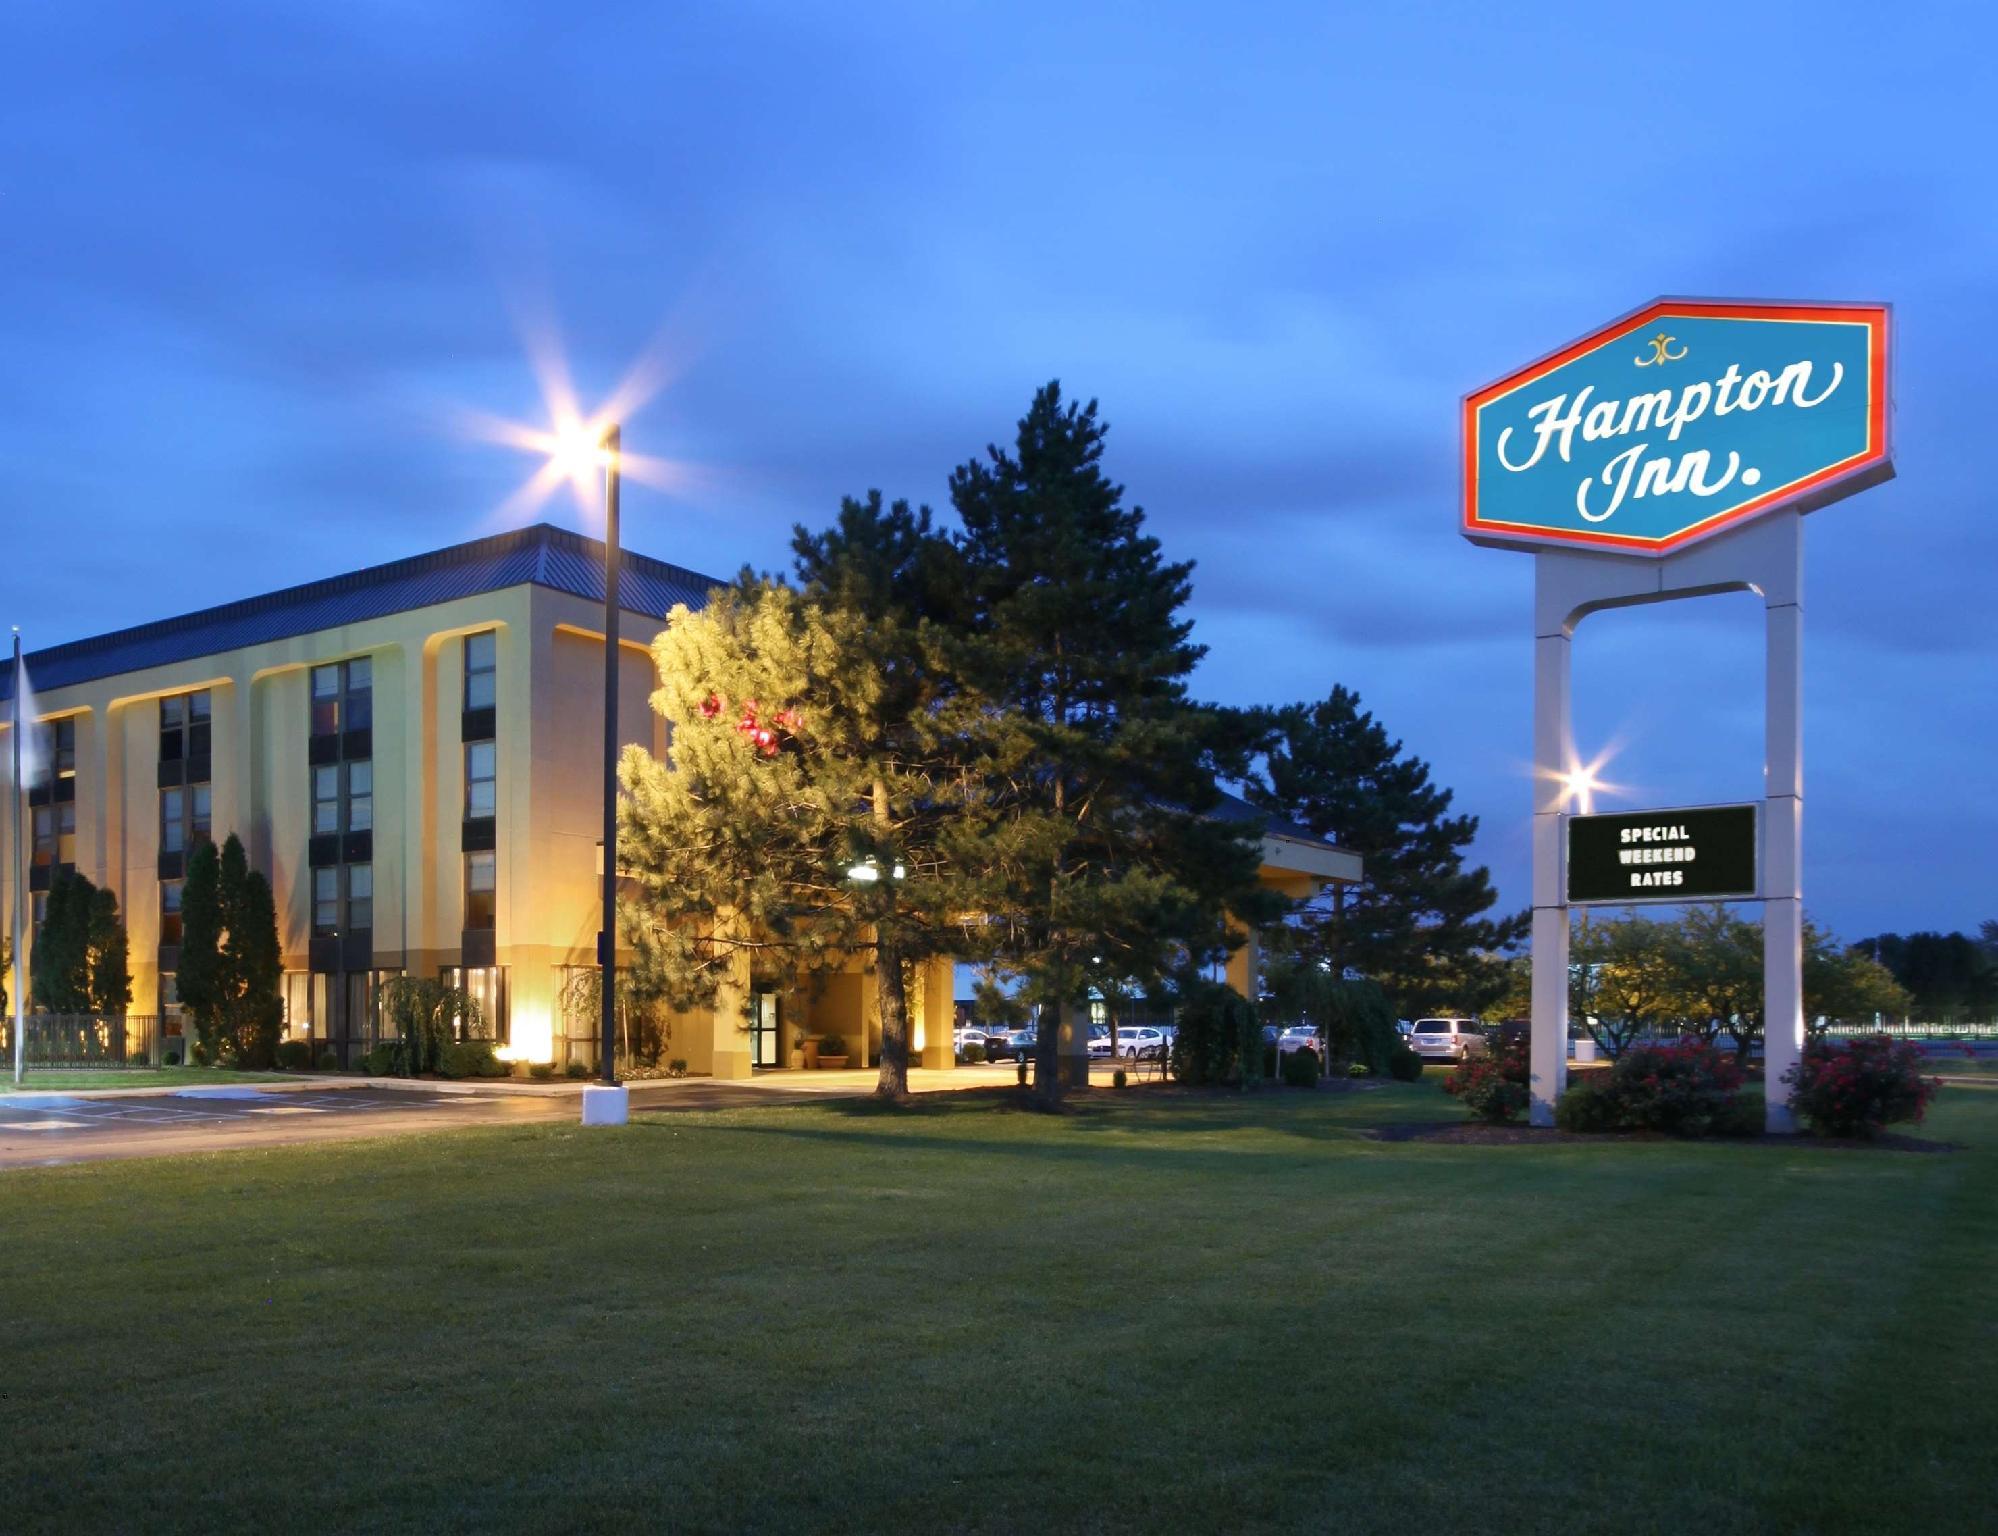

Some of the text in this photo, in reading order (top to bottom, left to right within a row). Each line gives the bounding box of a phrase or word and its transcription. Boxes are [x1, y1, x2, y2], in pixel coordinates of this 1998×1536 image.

[1498, 361, 1844, 472] Hampton
[1620, 826, 1689, 842] SPECIAL
[1619, 847, 1696, 864] WEEKEND
[1630, 871, 1683, 886] RATES
